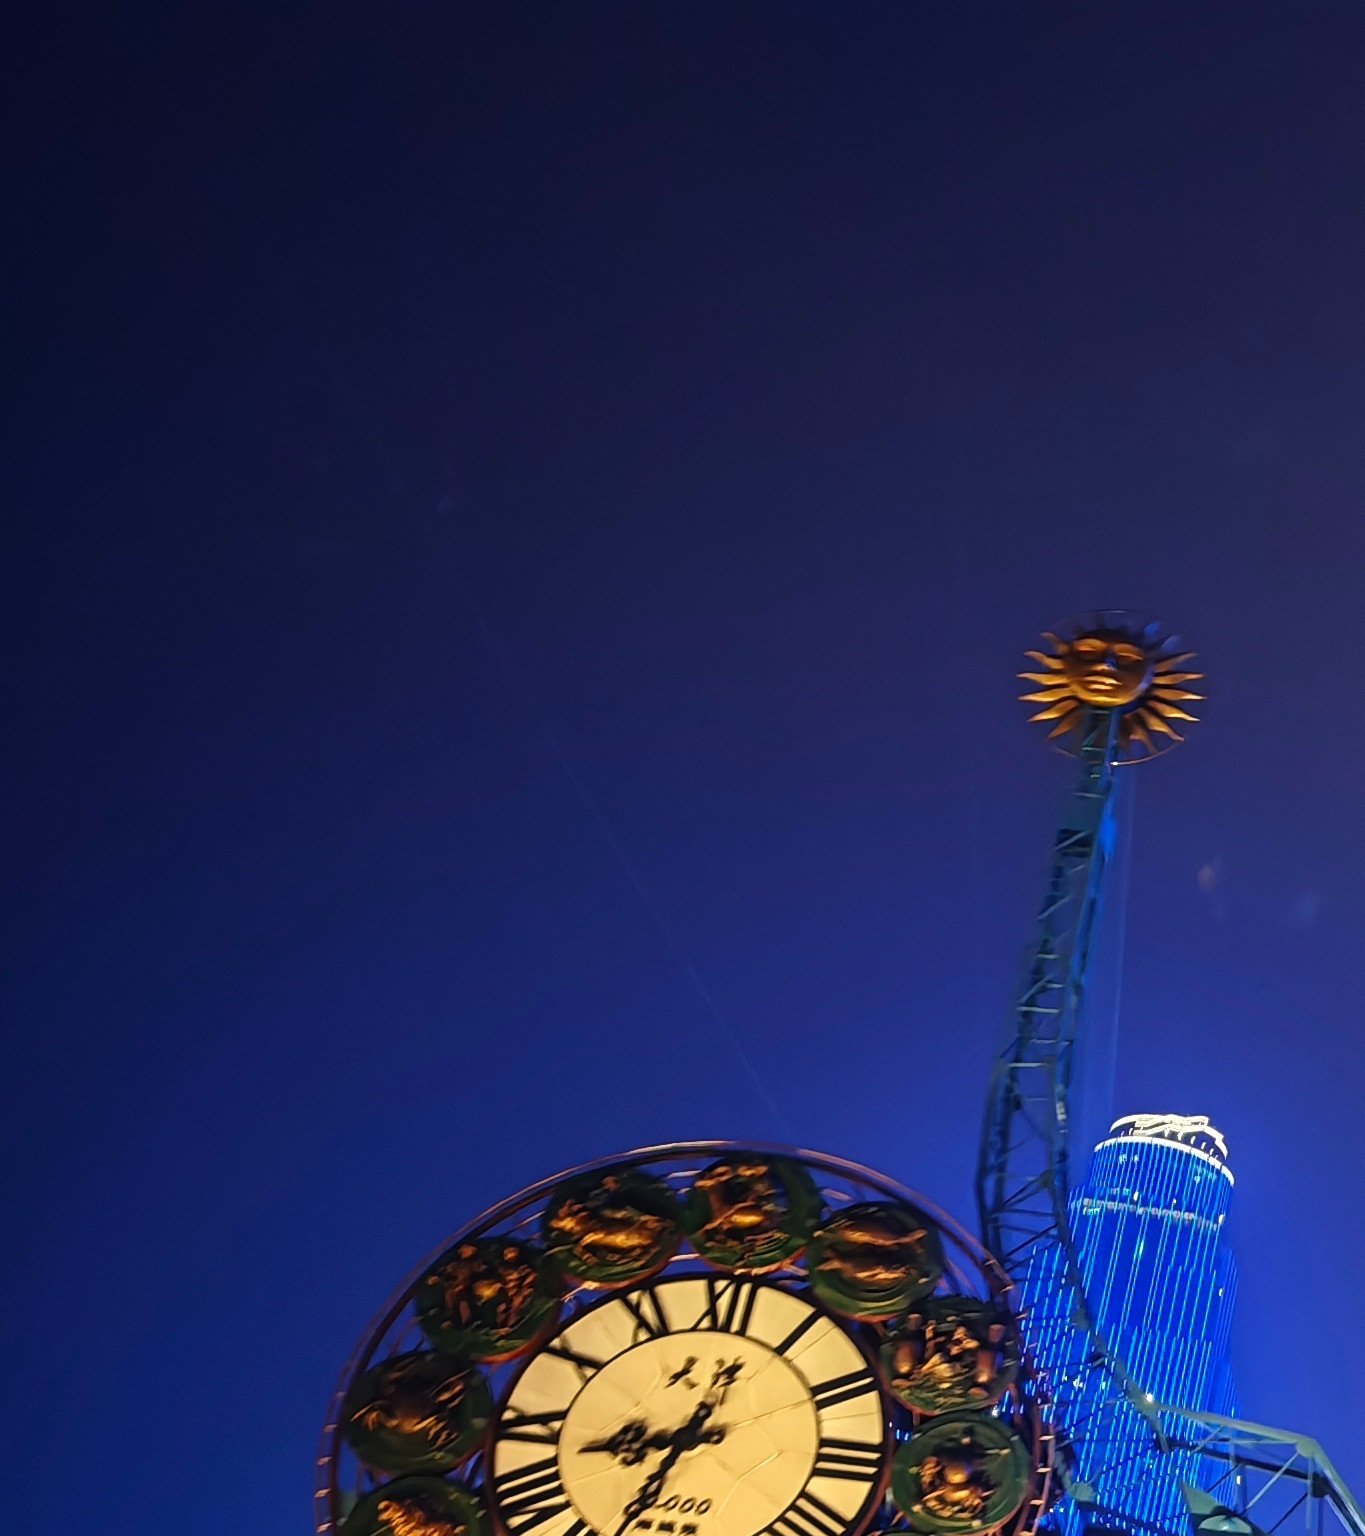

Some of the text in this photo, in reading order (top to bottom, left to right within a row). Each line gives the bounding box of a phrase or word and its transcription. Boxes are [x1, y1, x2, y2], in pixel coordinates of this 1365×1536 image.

[622, 1287, 668, 1342] XI
[690, 1278, 759, 1337] XII
[774, 1305, 828, 1358] I
[547, 1333, 603, 1381] X
[808, 1367, 878, 1412] II
[499, 1404, 565, 1444] IX
[811, 1437, 886, 1484] III
[648, 1494, 712, 1516] 000
